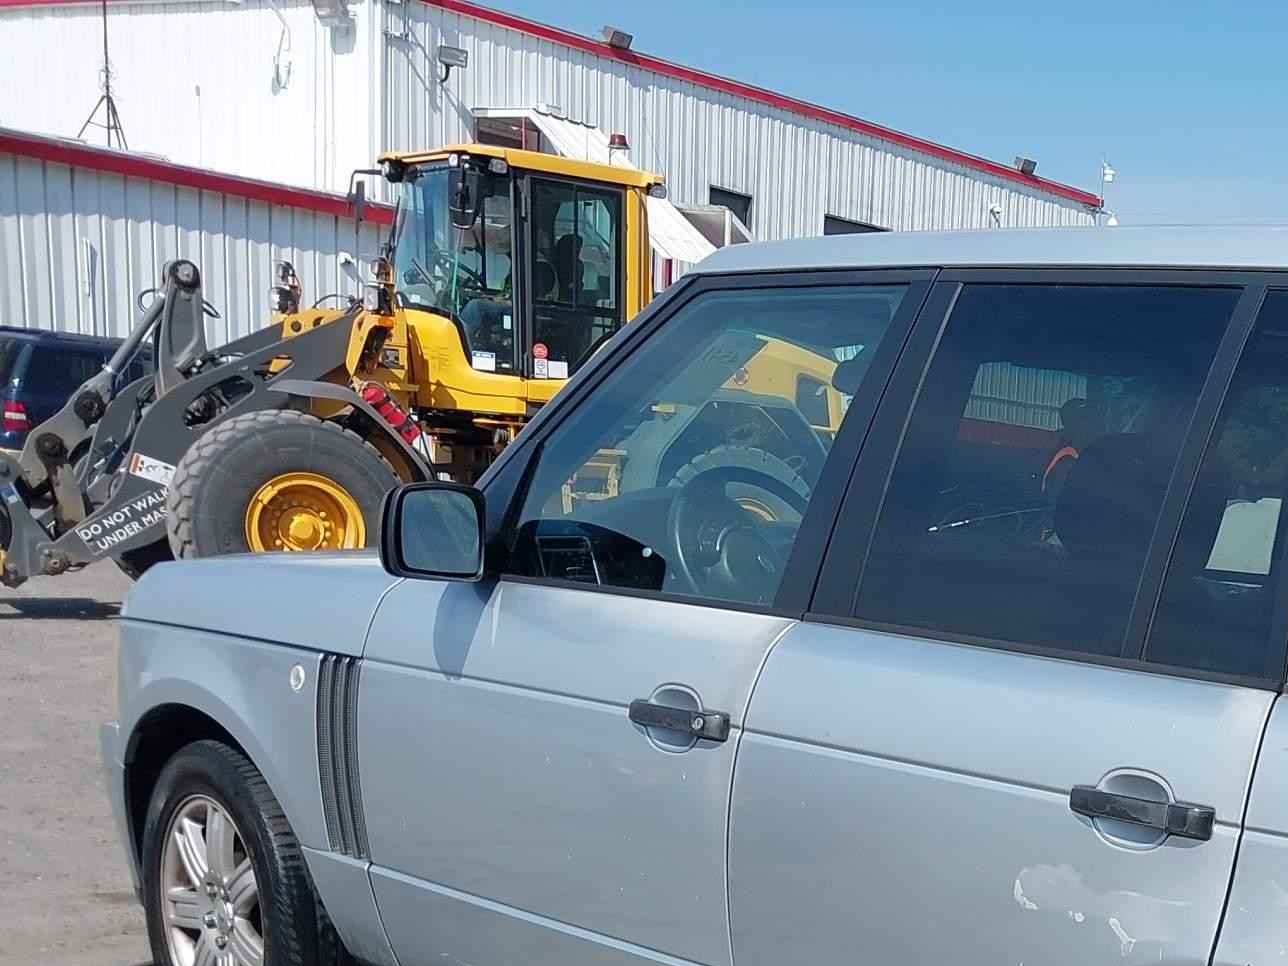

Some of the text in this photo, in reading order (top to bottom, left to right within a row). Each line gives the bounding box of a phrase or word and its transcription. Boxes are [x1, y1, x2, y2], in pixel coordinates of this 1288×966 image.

[80, 487, 169, 541] DO NOT WALK
[96, 506, 168, 550] UNDER MAS
